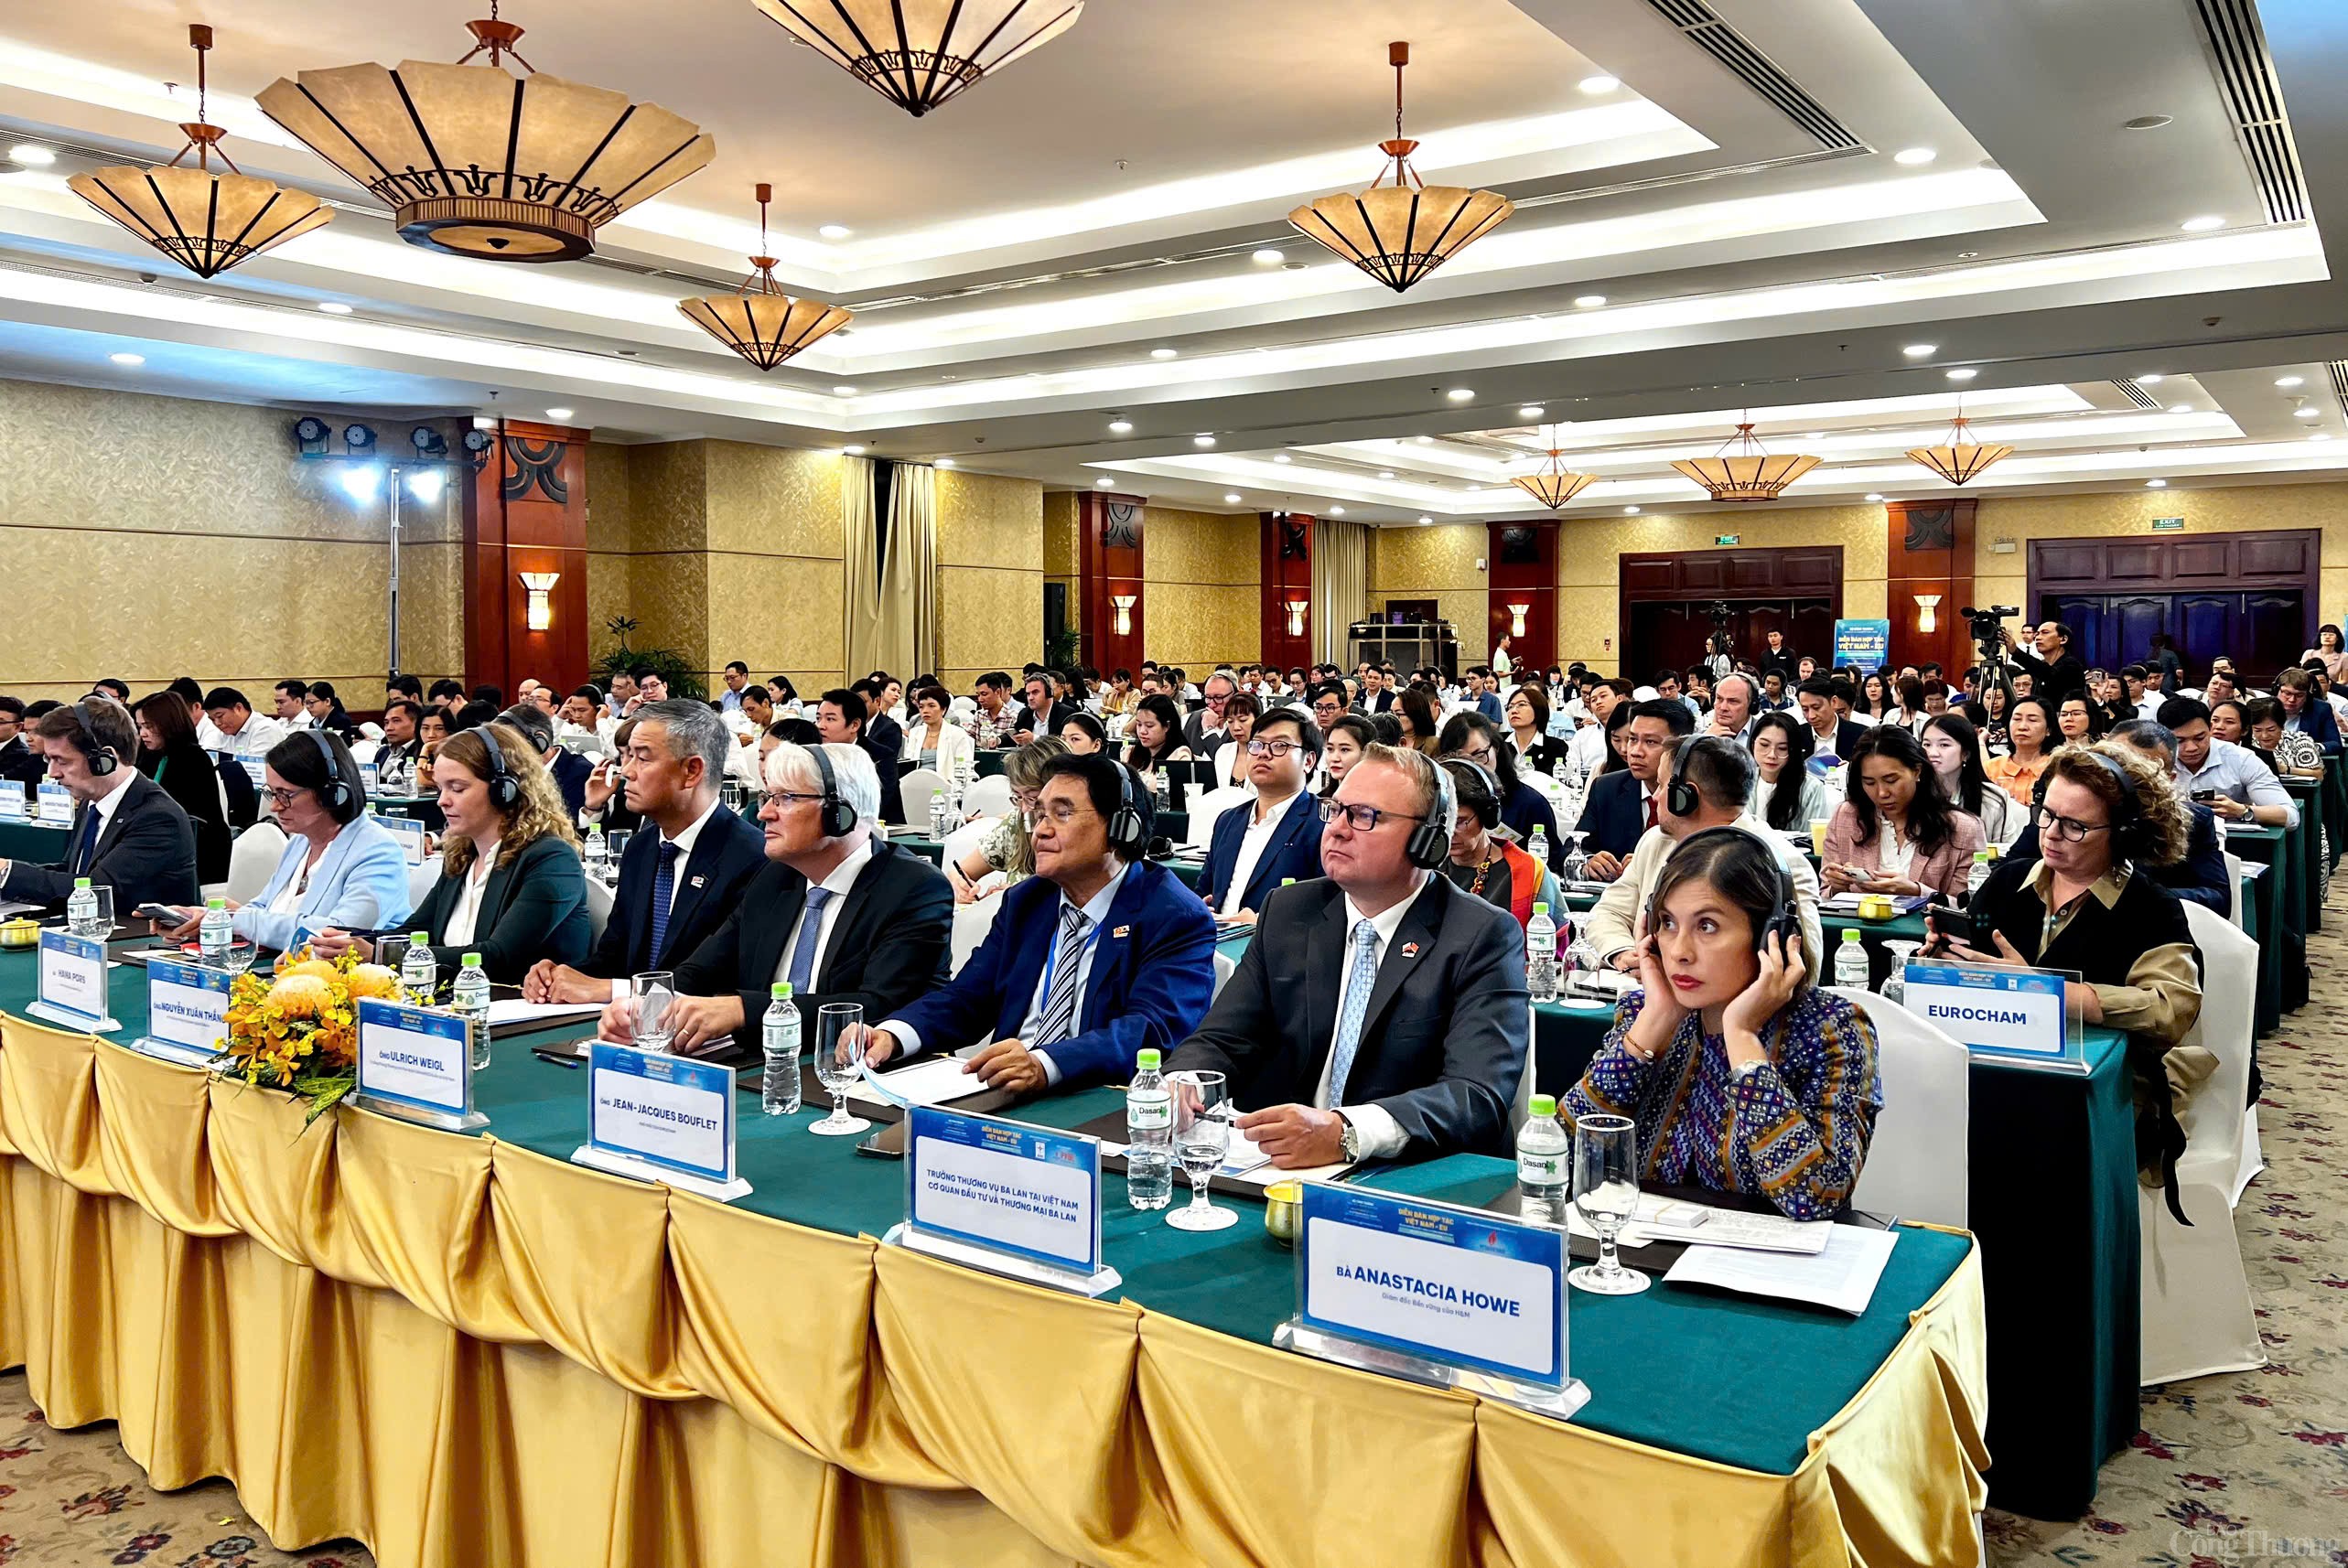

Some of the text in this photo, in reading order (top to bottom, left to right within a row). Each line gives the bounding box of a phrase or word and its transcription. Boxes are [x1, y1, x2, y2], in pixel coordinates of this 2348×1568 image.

[1928, 1004, 2027, 1026] EUROCHAM
[391, 1050, 418, 1066] ULRICH
[419, 1057, 445, 1071] WEIGL
[677, 1112, 717, 1131] BOUFLET
[940, 1185, 960, 1196] QUAN
[1000, 1197, 1032, 1212] THƯƠNG
[1049, 1208, 1059, 1219] BA
[1061, 1212, 1077, 1223] LAN
[957, 1176, 987, 1189] THƯƠNG
[1000, 1185, 1011, 1195] BA
[1012, 1187, 1028, 1198] LAN
[1042, 1194, 1060, 1207] VIỆT
[1061, 1199, 1079, 1210] NAM
[1336, 1264, 1520, 1317] BÀ ANASTACIA HOWE
